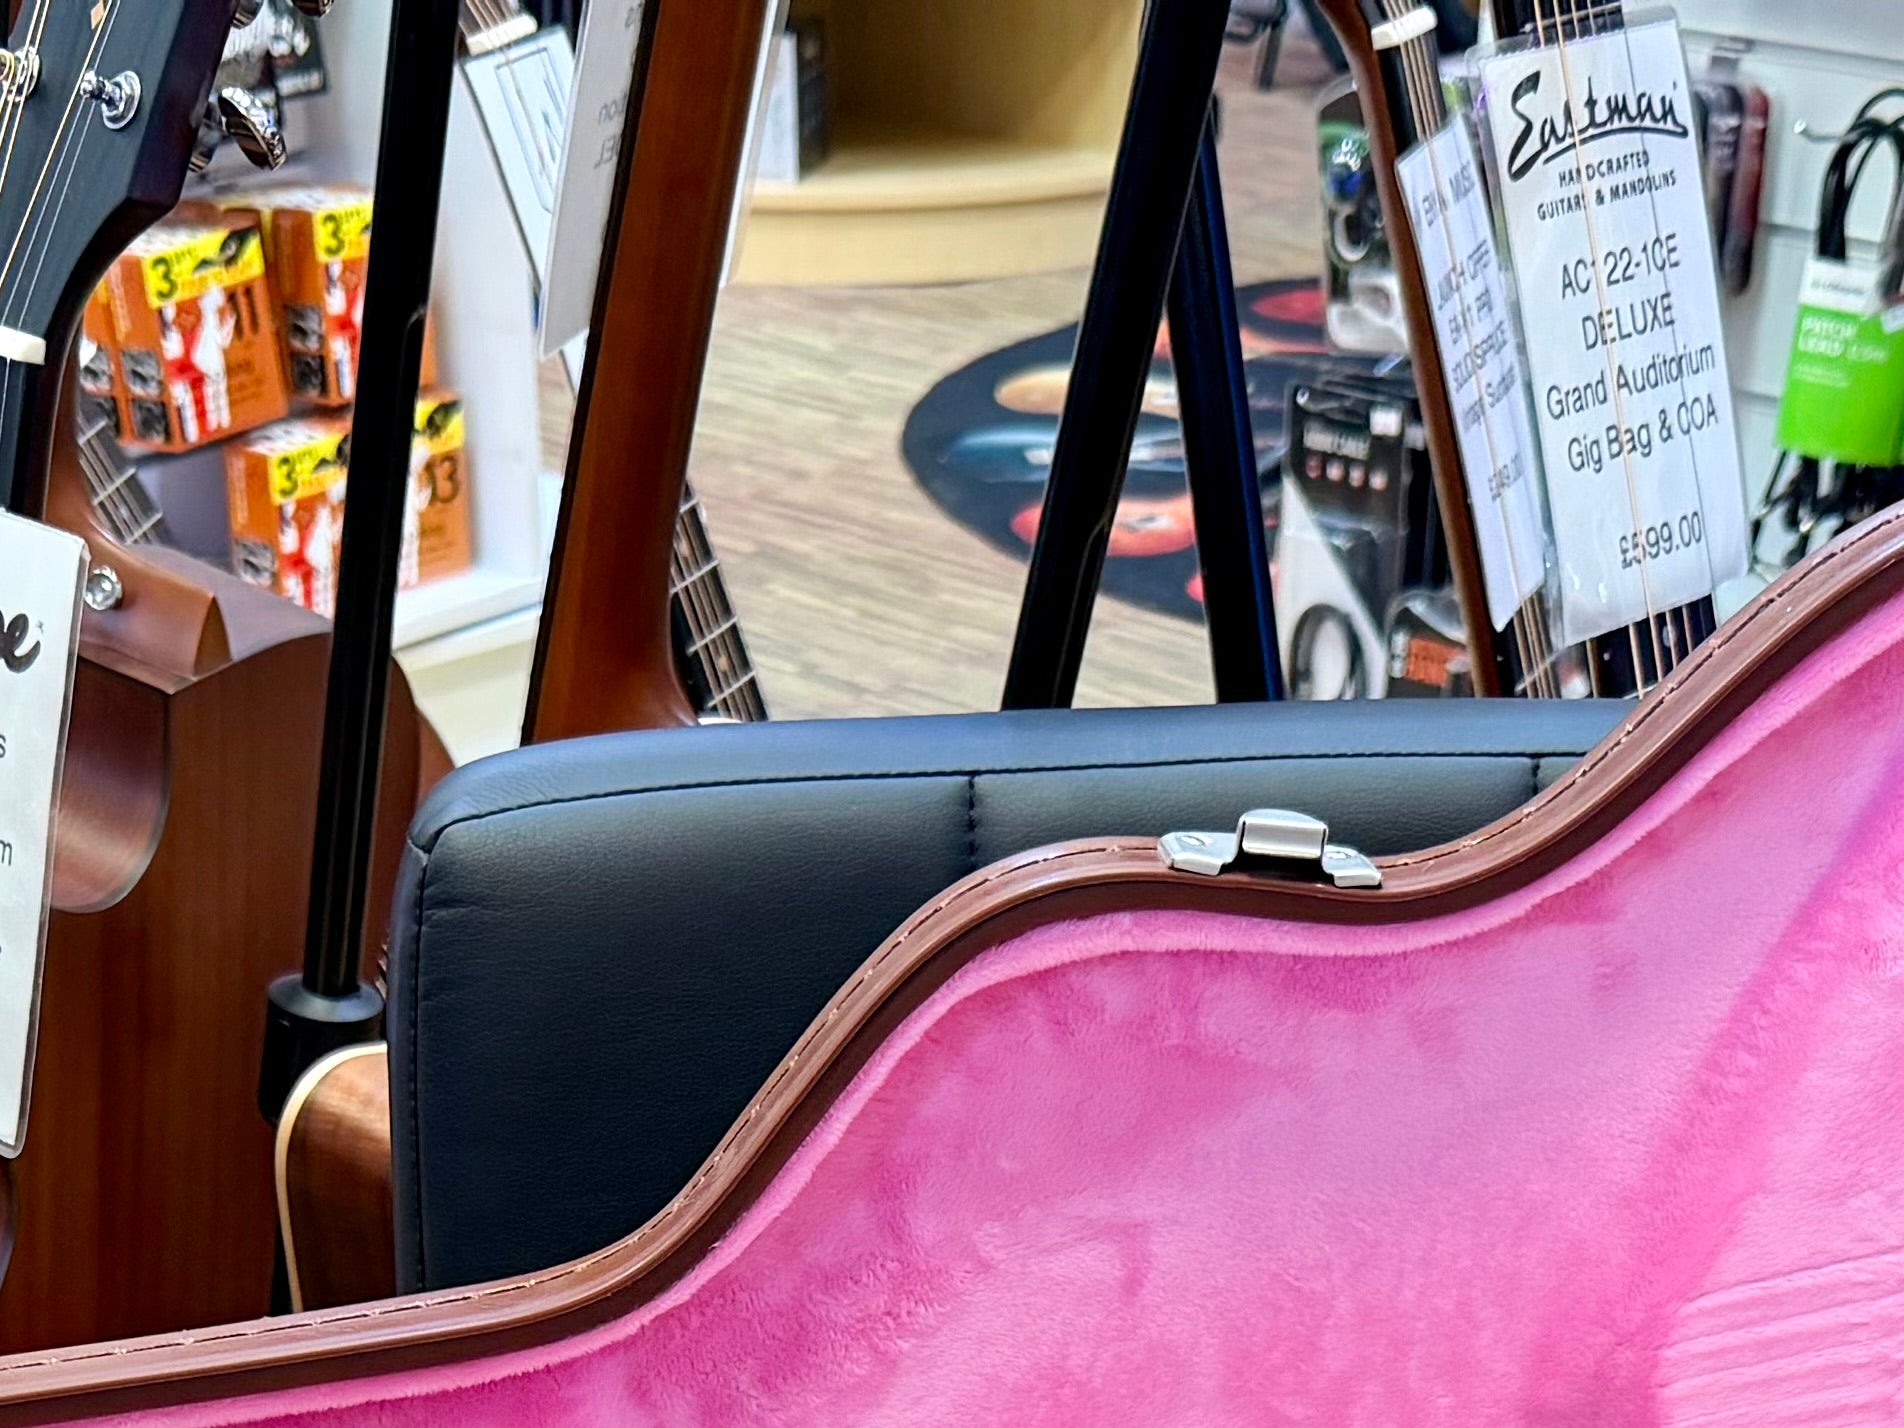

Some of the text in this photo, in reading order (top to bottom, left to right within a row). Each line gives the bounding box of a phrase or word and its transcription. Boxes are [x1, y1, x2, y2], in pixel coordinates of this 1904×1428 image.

[1507, 69, 1690, 183] Eastman
[1557, 149, 1650, 189] HANDCRAFTED
[1595, 187, 1605, 206] &
[1609, 168, 1677, 204] MANDOLINS
[318, 213, 345, 256] 3
[149, 256, 178, 301] 3
[1581, 291, 1676, 351] DELUXE
[1545, 368, 1609, 421] Grand
[1615, 342, 1716, 397] Auditorium
[1567, 392, 1719, 475] Gig Bag & COA
[274, 457, 298, 498] 3
